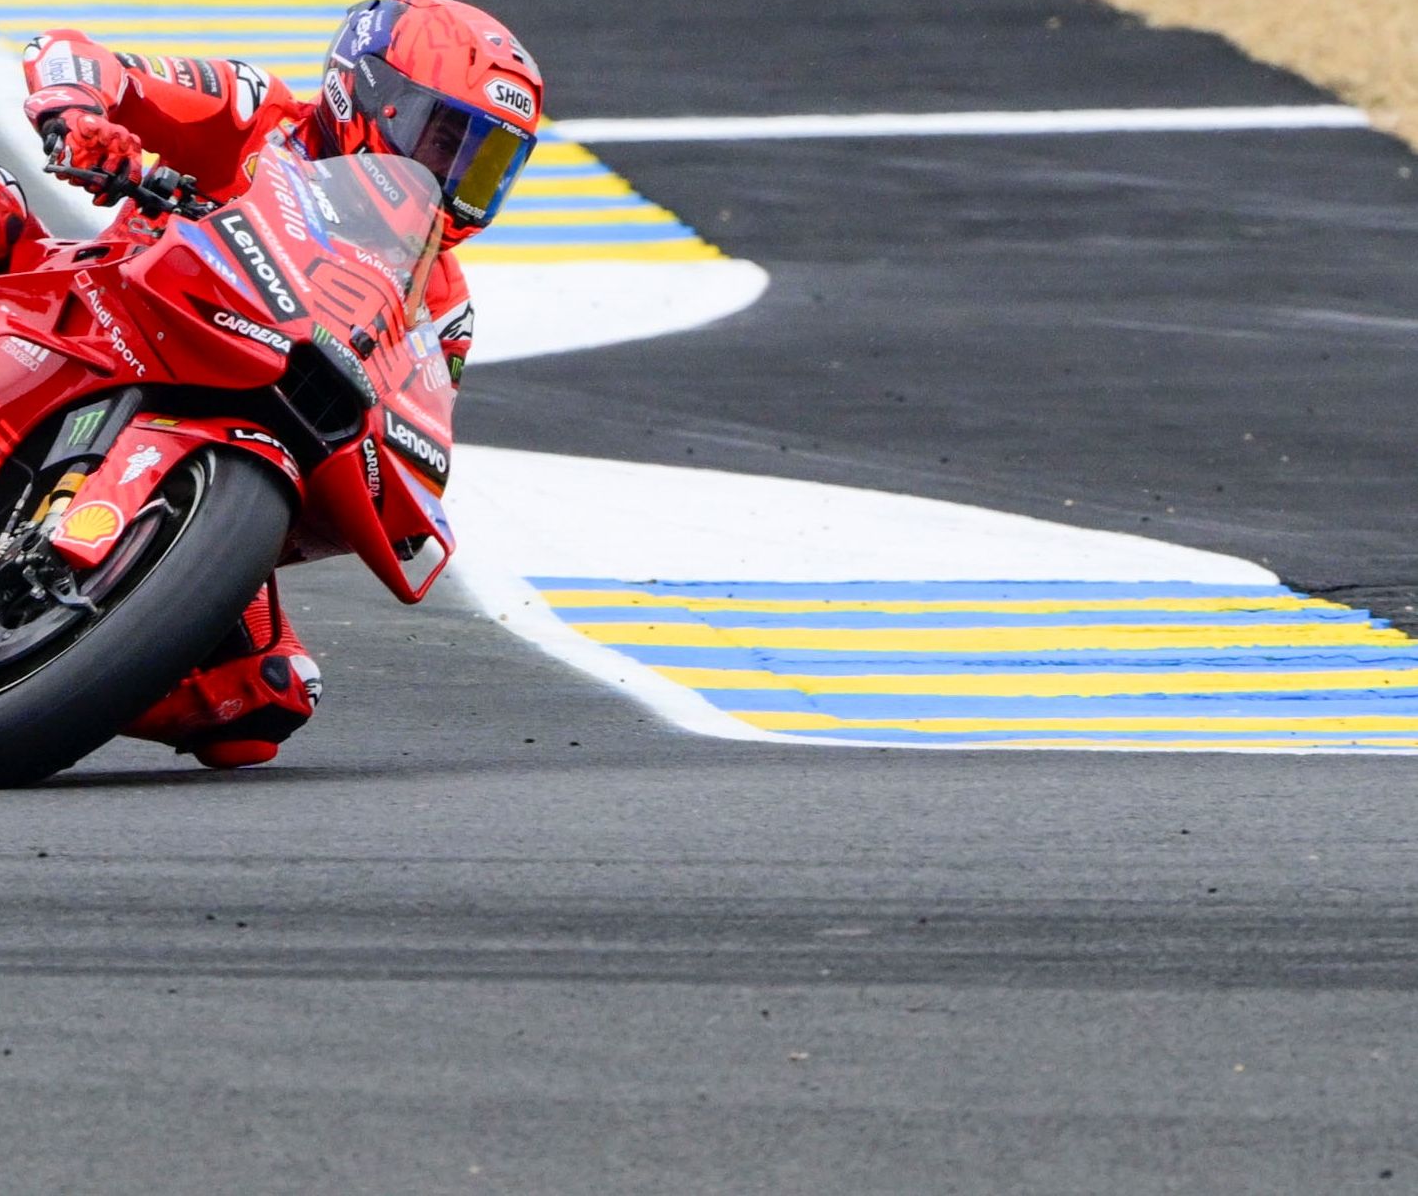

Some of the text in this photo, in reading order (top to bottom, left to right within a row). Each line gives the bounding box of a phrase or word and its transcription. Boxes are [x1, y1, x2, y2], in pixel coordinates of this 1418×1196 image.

[326, 74, 348, 116] SHOEI
[495, 84, 532, 115] SHOEI
[357, 147, 400, 202] Lenovo
[221, 214, 296, 314] Lenovo
[86, 289, 146, 378] Audi Sport
[213, 311, 293, 353] CARRERA
[362, 438, 382, 498] CARRERA
[385, 411, 447, 474] Lenovo
